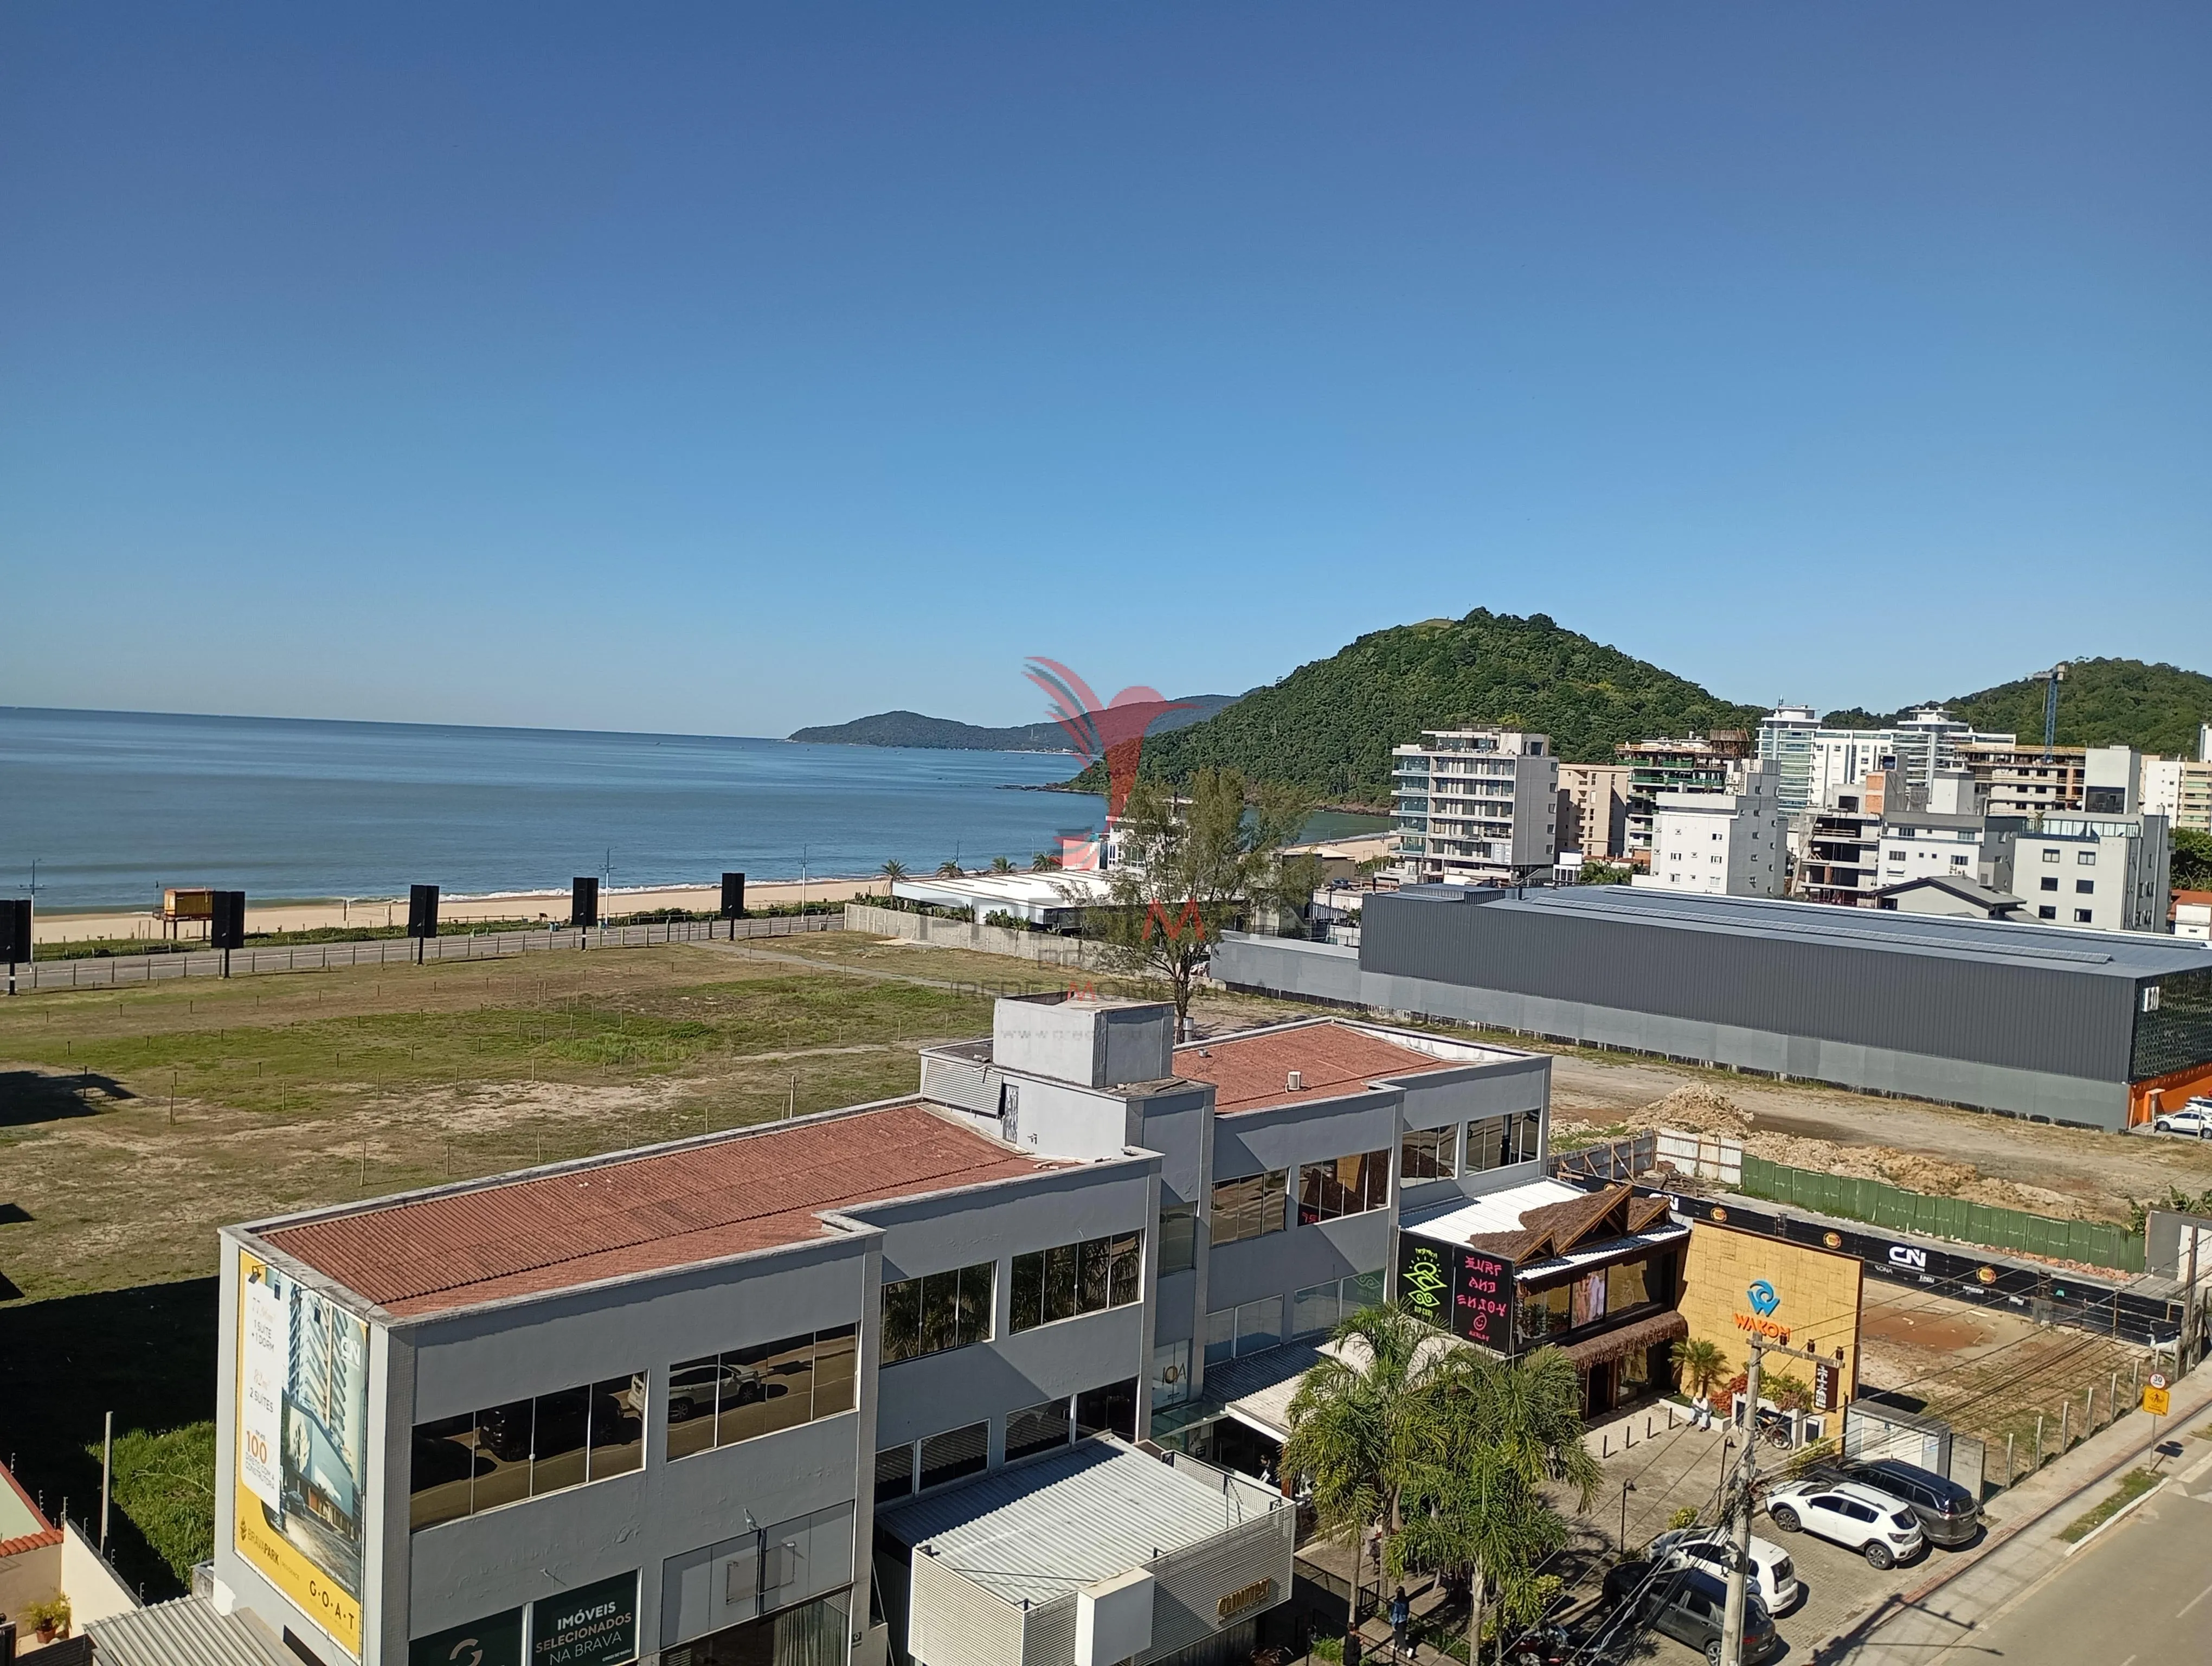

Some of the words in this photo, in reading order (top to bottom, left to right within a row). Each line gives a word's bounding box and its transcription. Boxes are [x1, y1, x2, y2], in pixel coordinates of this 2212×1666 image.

[1889, 1246, 1926, 1267] CN
[2153, 1375, 2163, 1383] 30
[557, 1601, 616, 1631] IMÓVEIS
[535, 1612, 632, 1653] SELECIONADOS
[549, 1649, 571, 1665] NA
[575, 1631, 622, 1657] BRAVA
